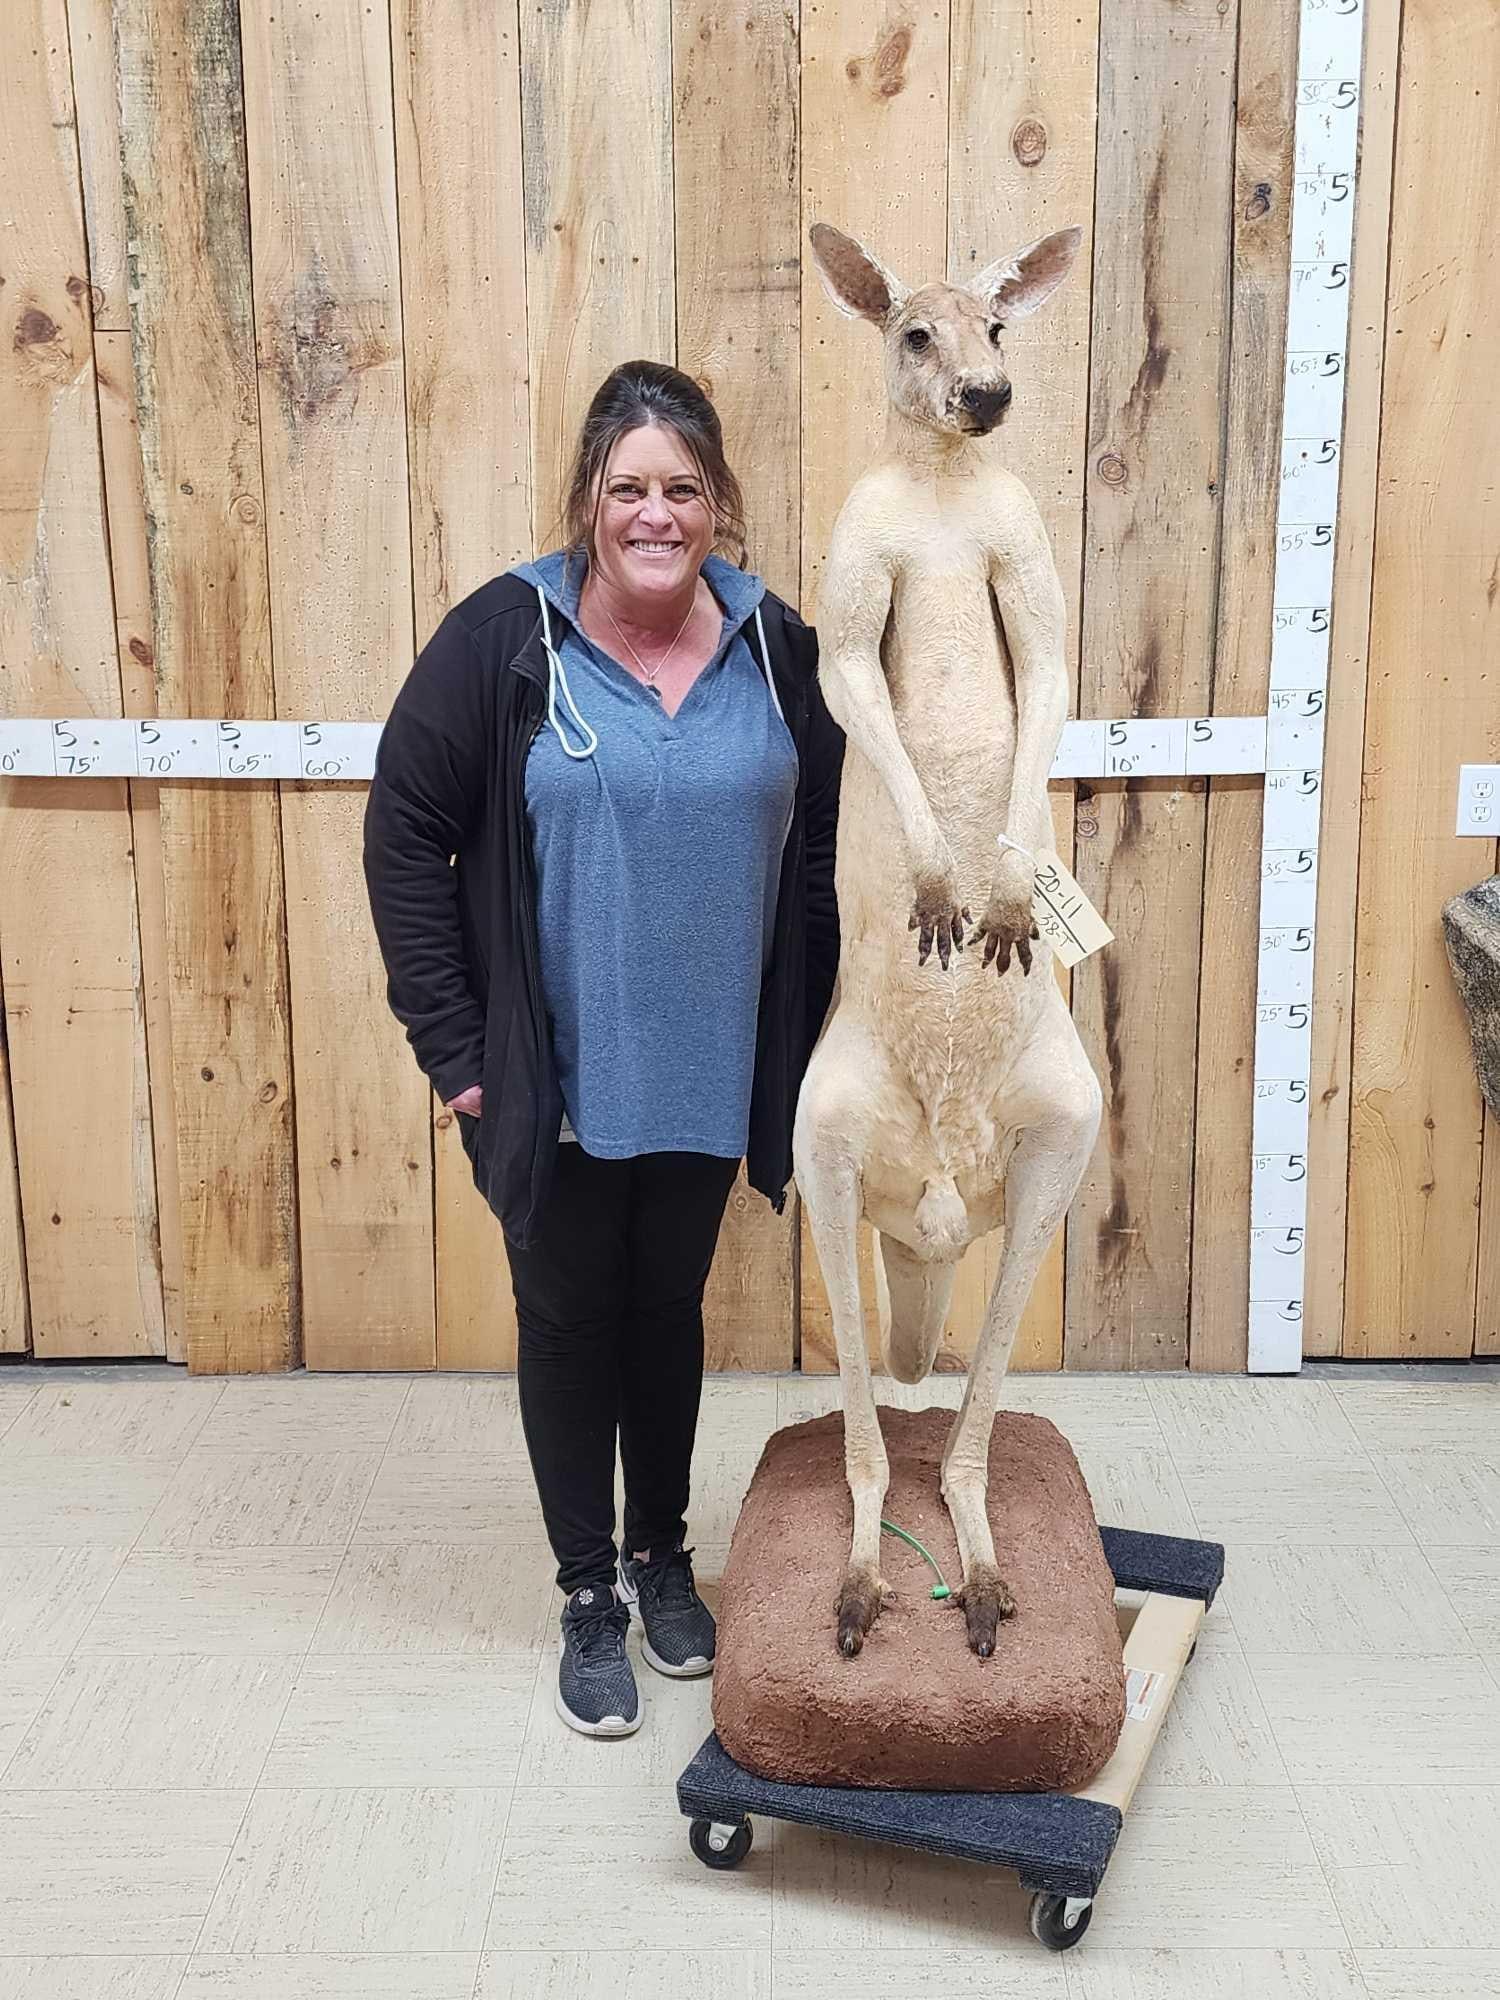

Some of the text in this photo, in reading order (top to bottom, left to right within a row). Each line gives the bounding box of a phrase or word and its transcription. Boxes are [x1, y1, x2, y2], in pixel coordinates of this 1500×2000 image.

[54, 720, 78, 748] 5
[140, 721, 161, 744] 5
[219, 721, 241, 742] 5
[303, 723, 322, 745] 5
[1108, 721, 1128, 746] 5
[1192, 719, 1213, 742] 5
[1, 748, 20, 771] 0"
[58, 754, 100, 774] 75"
[142, 751, 181, 773] 70"
[228, 754, 271, 774] 65"
[305, 756, 350, 777] 60"
